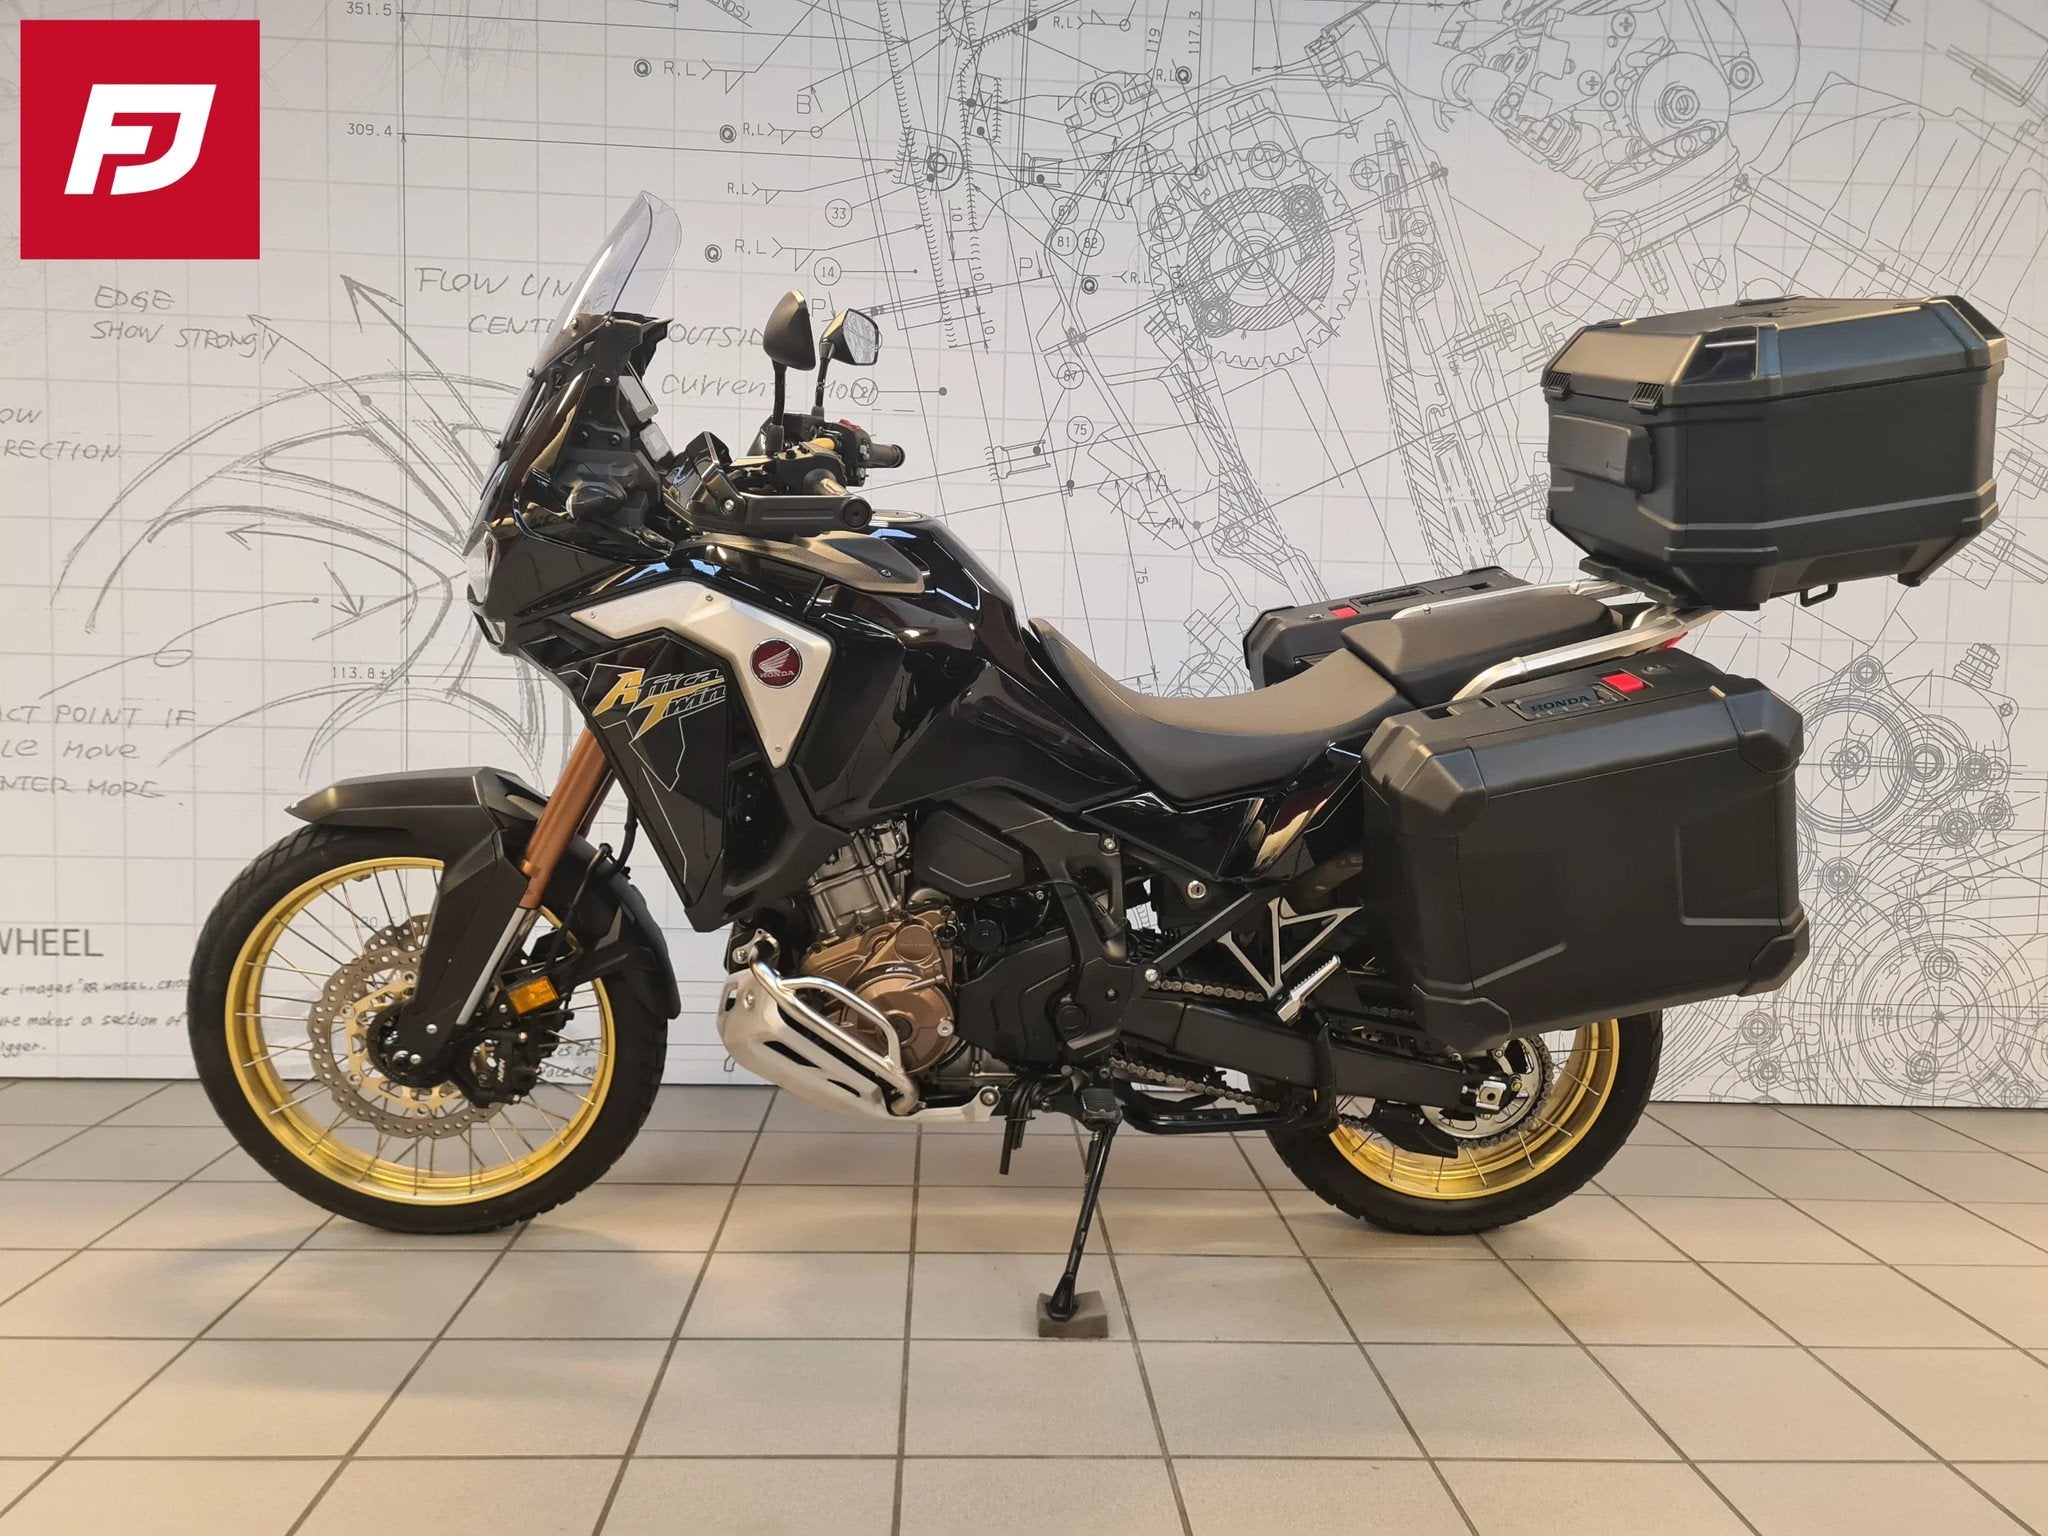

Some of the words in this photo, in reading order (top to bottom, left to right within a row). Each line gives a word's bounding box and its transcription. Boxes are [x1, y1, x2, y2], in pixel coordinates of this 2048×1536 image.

[346, 1, 392, 16] 351.5
[1146, 28, 1160, 53] 119
[797, 94, 811, 114] B
[347, 123, 392, 137] 309.4
[832, 207, 846, 220] 33
[1057, 236, 1071, 247] 81
[1084, 237, 1098, 248] 82
[821, 266, 834, 278] 14
[1019, 257, 1033, 276] P
[415, 267, 508, 294] FLOW
[94, 284, 175, 312] EDGE
[91, 320, 163, 343] SHOW
[1073, 423, 1087, 435] 75
[4, 439, 121, 461] RECTION
[1136, 567, 1149, 584] 75
[760, 670, 795, 678] HONDA
[1531, 695, 1590, 712] HONDA
[55, 704, 142, 728] POINT
[165, 709, 196, 728] IF
[87, 779, 165, 798] MORE
